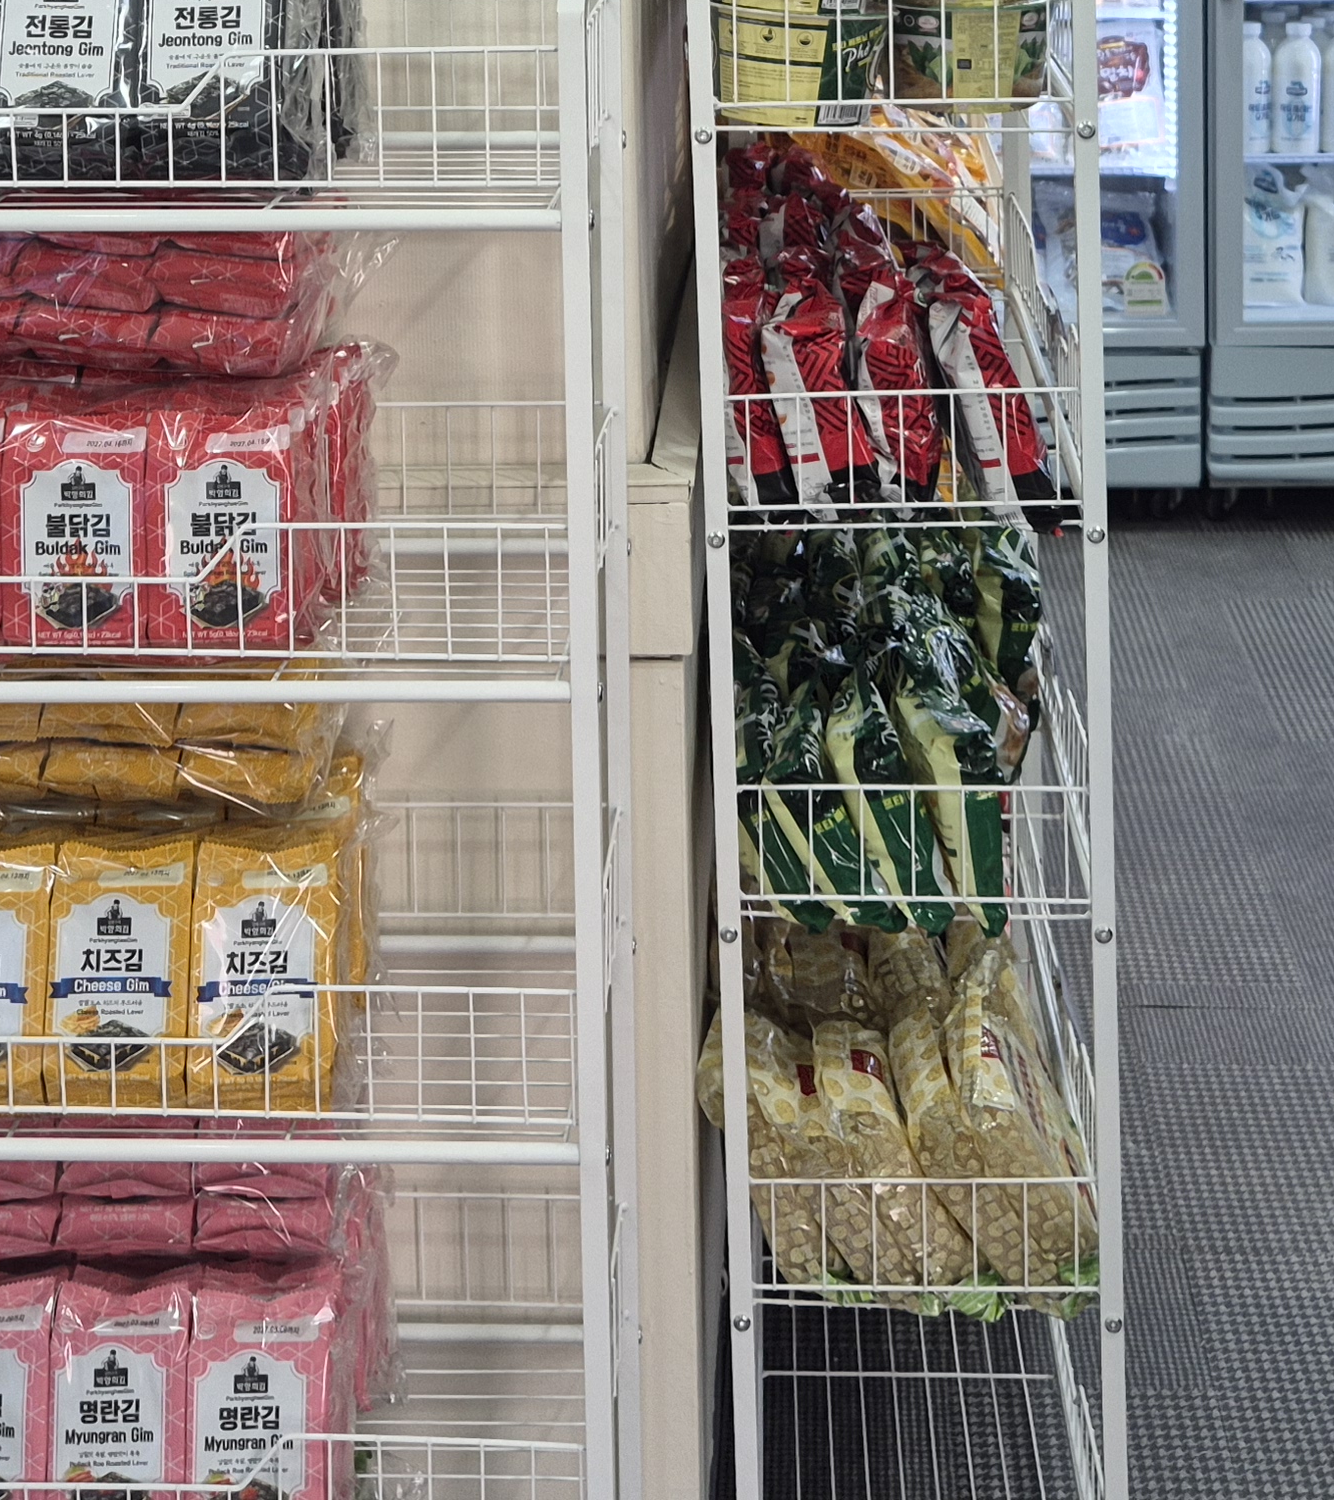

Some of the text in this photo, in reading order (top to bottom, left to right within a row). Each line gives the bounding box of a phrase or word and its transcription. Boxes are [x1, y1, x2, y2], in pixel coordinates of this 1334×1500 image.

[25, 15, 94, 39] 전통김
[174, 6, 241, 30] 전통김
[9, 41, 104, 57] Jeontong Gim
[158, 32, 253, 48] Jeontong Gim
[46, 513, 111, 538] 불닭김
[190, 512, 257, 537] 불닭김
[35, 540, 121, 556] Buldak Gim
[240, 539, 268, 554] Gim
[80, 948, 144, 973] 치즈김
[226, 950, 288, 975] 치즈김
[74, 978, 150, 992] Cheese Gim
[218, 981, 265, 995] Cheese
[79, 1399, 140, 1424] 명란김
[219, 1405, 280, 1431] 명란김
[65, 1428, 154, 1445] Myungran Gim
[204, 1436, 266, 1452] Myungran
